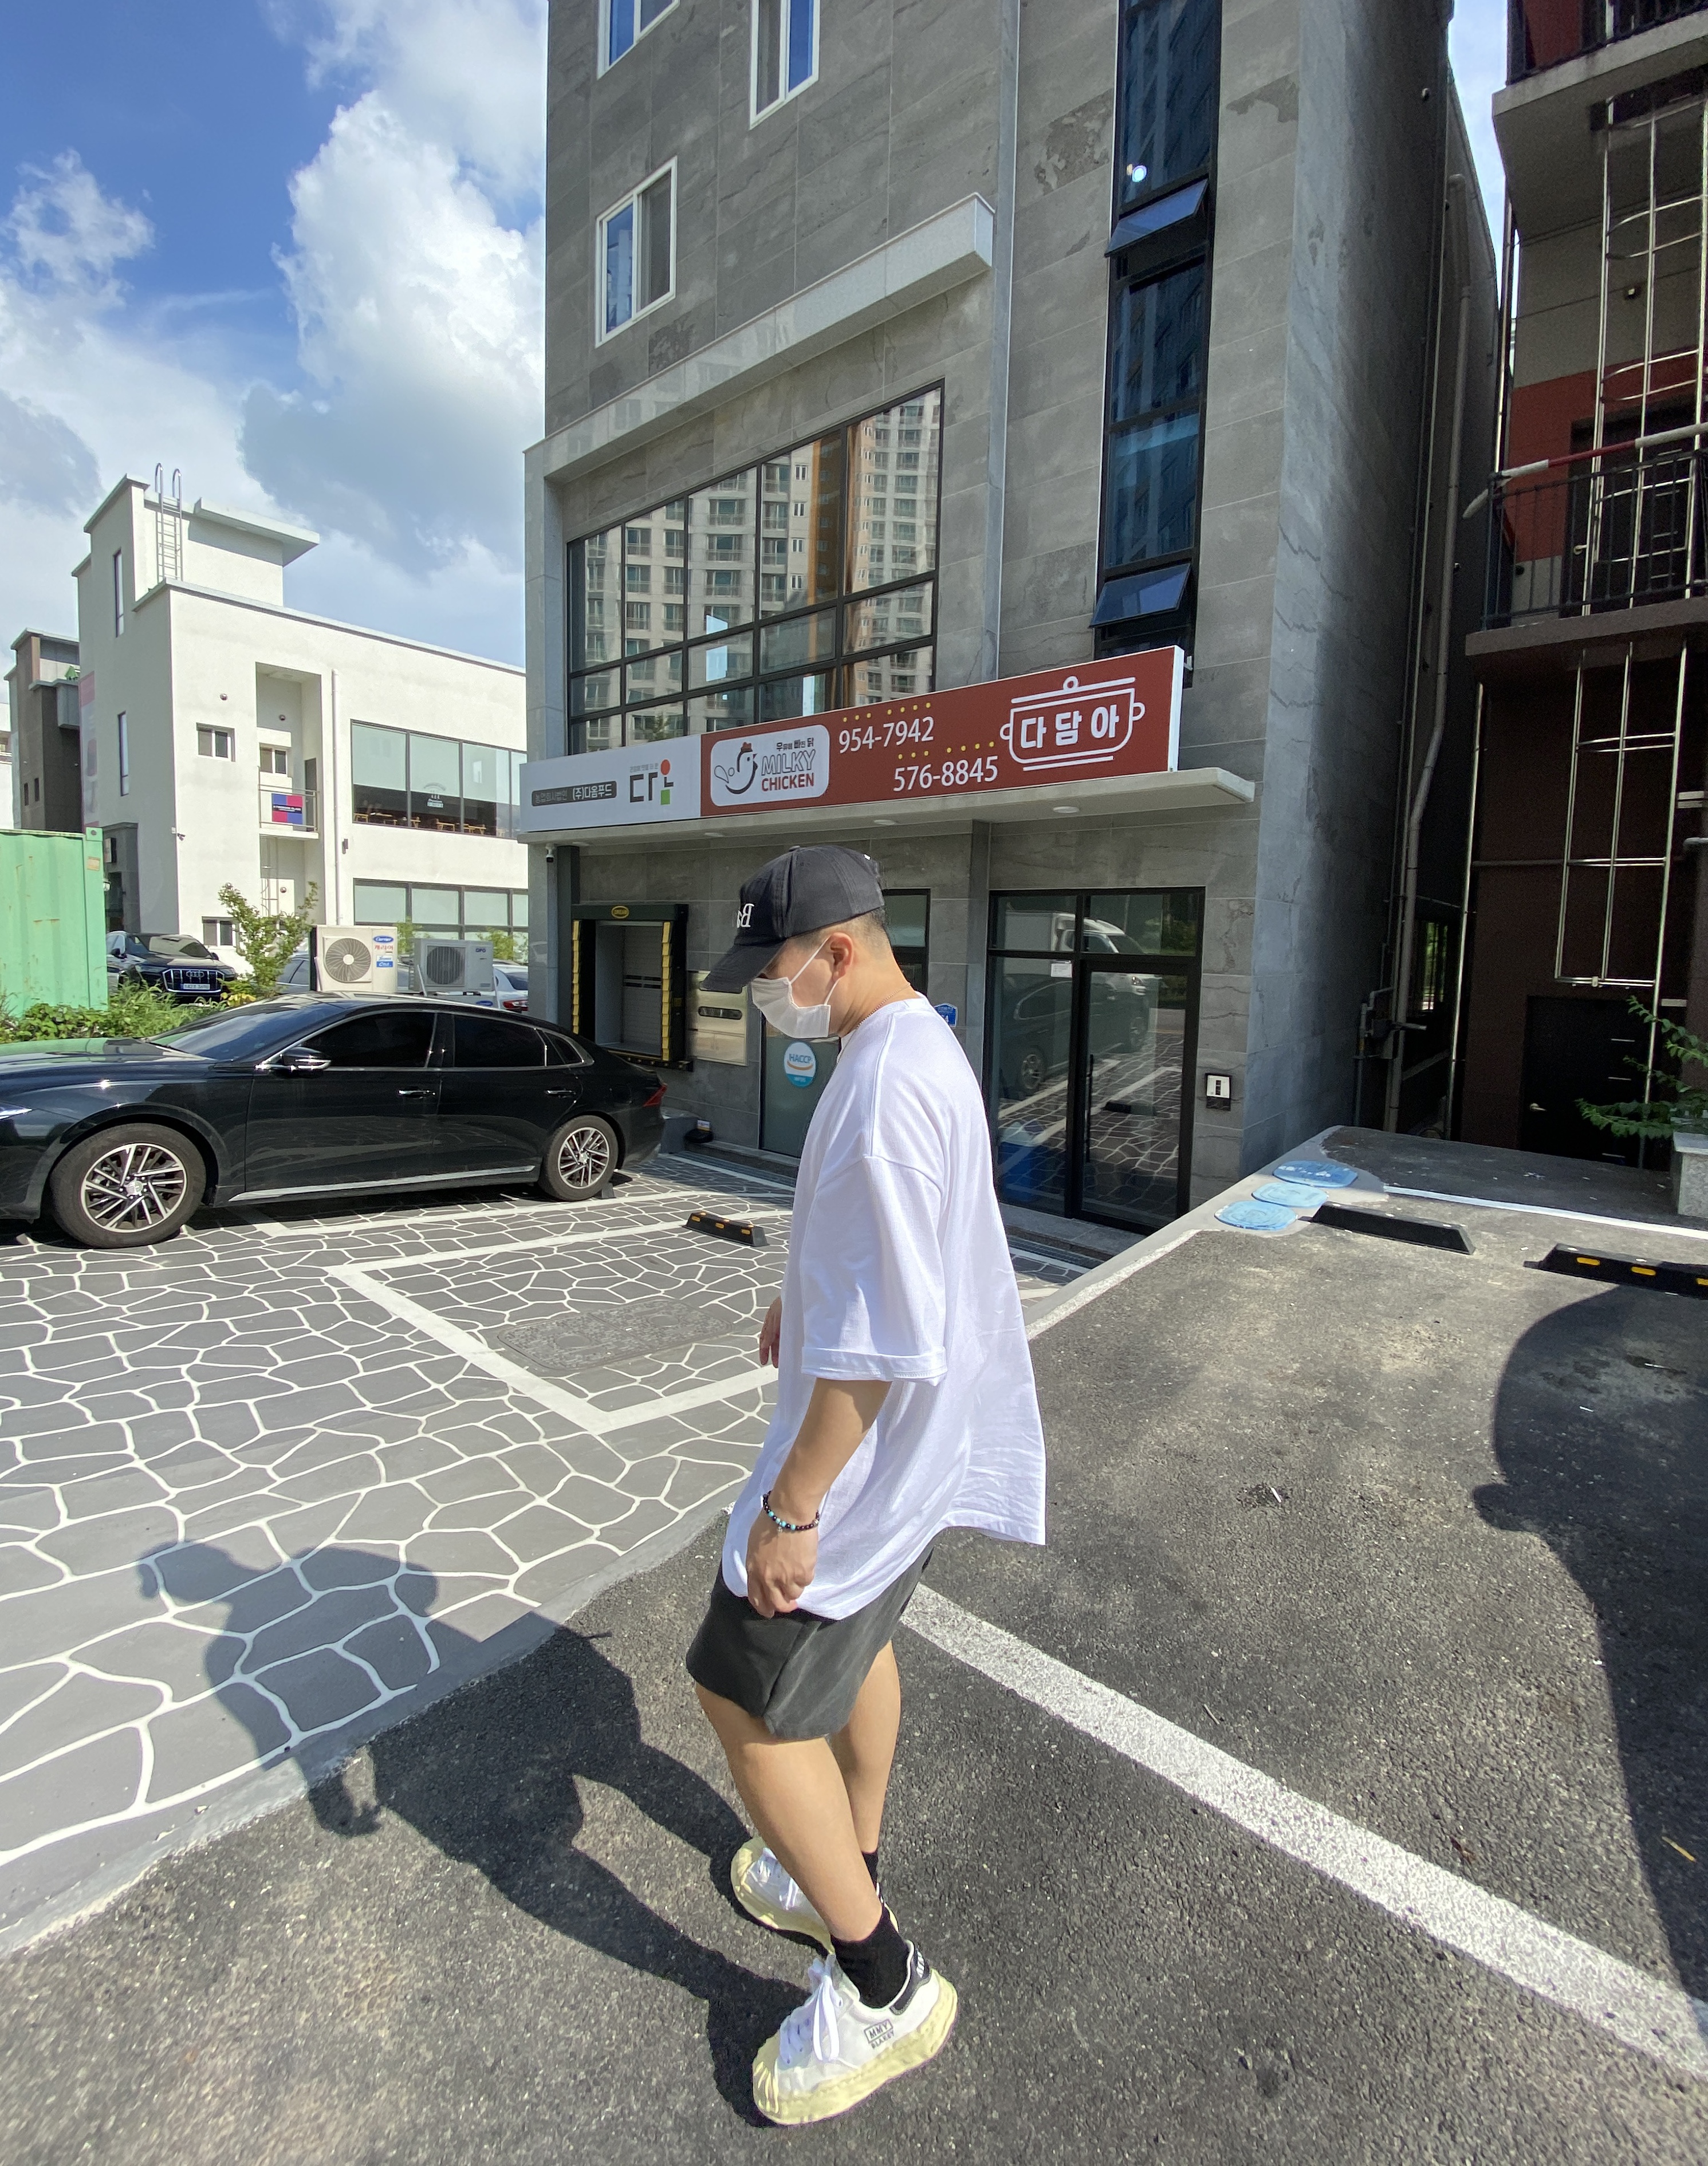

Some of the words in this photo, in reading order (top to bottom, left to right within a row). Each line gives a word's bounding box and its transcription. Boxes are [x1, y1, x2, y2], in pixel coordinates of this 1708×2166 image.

[839, 716, 934, 754] 954-7942
[1021, 704, 1120, 749] 다담아
[761, 749, 816, 776] MILKY
[893, 755, 998, 792] 576-8845
[761, 773, 814, 791] CHICKEN
[789, 1053, 812, 1064] HACCP
[869, 2021, 888, 2039] MMY
